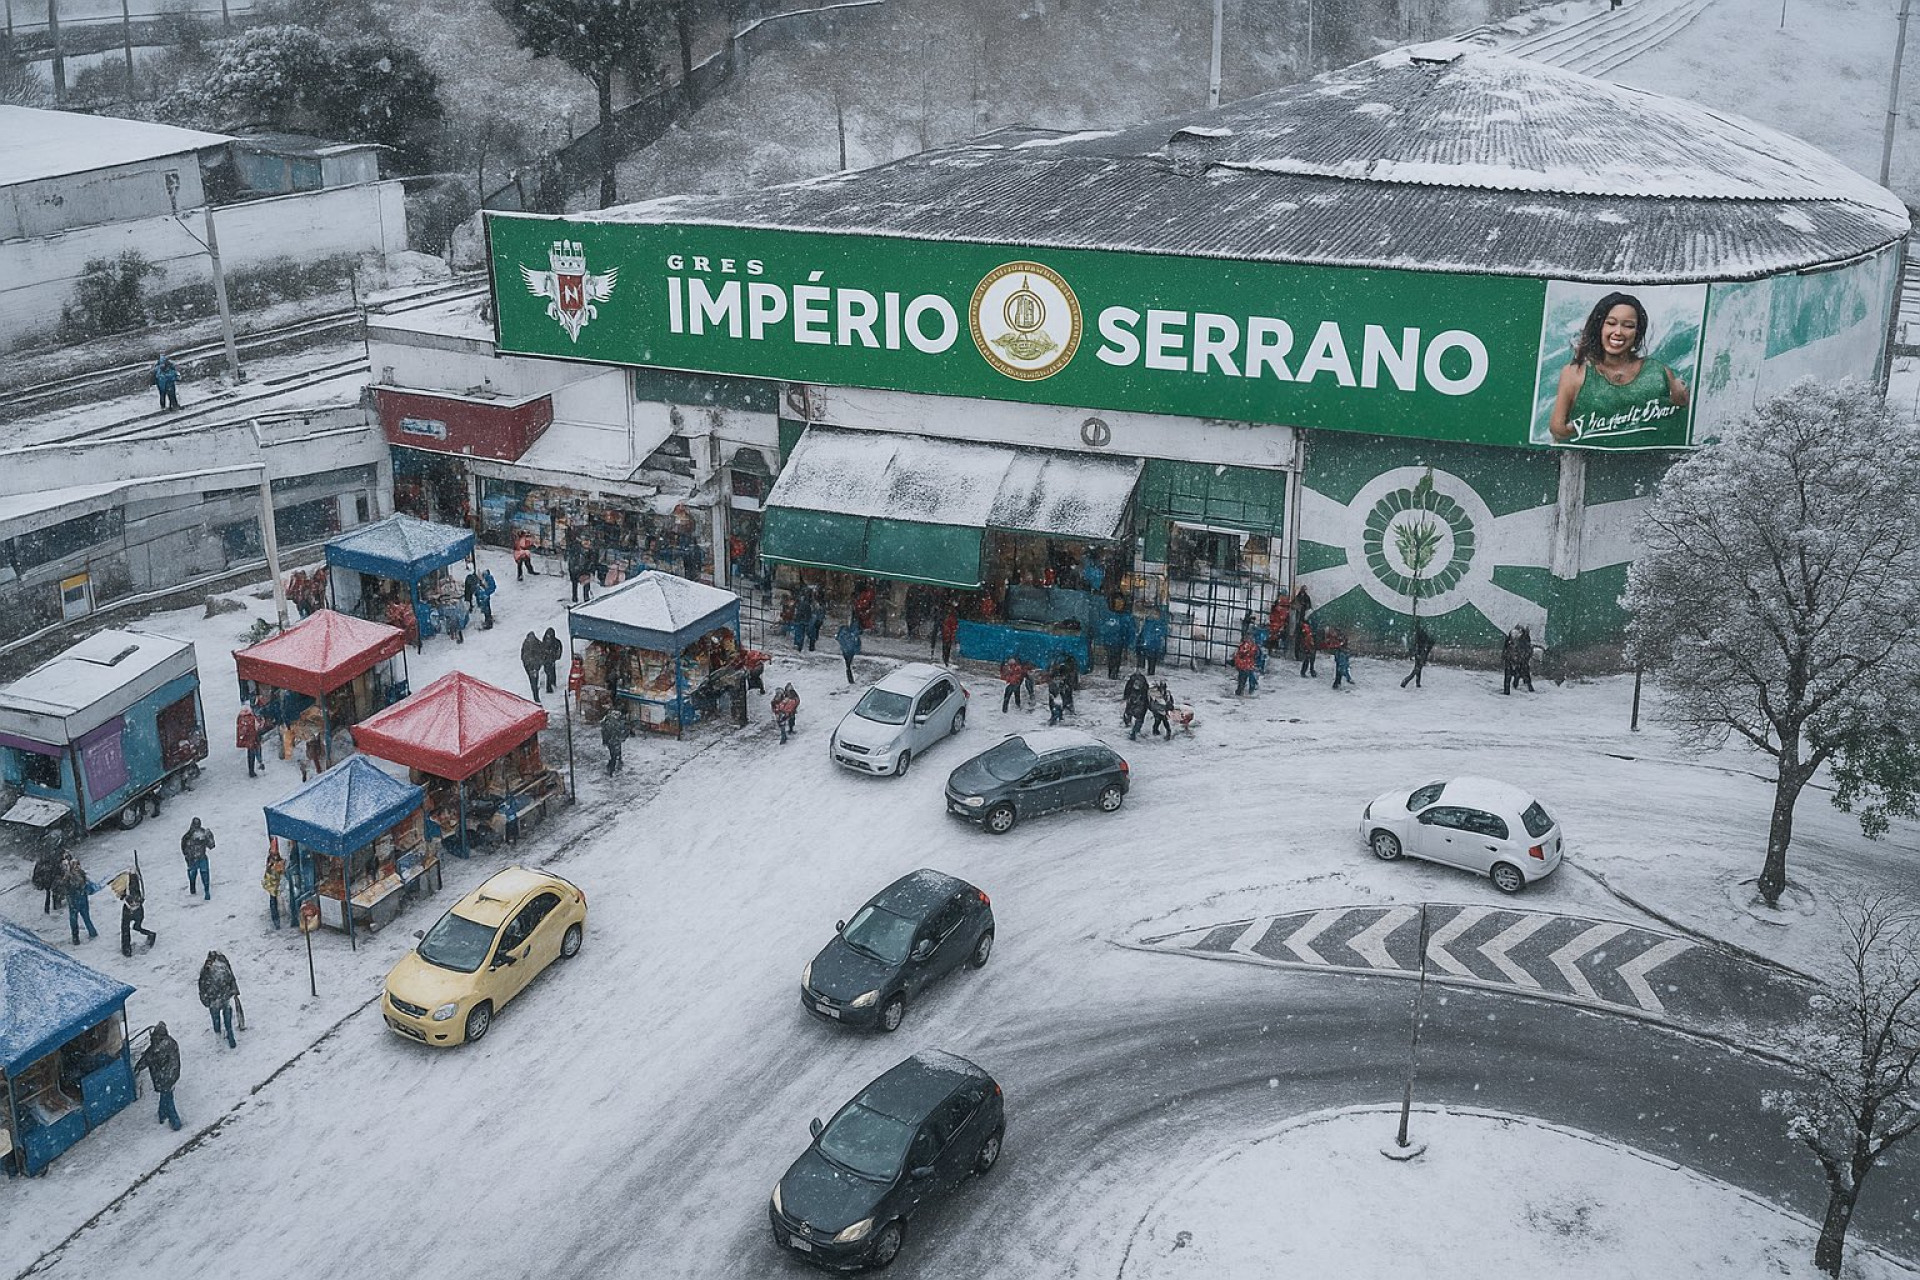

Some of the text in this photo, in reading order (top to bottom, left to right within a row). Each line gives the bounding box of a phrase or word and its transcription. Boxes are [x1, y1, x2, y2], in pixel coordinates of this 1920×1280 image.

[667, 255, 764, 275] GRES
[667, 271, 959, 354] IMPÉRIO
[1096, 306, 1489, 396] SERRANO
